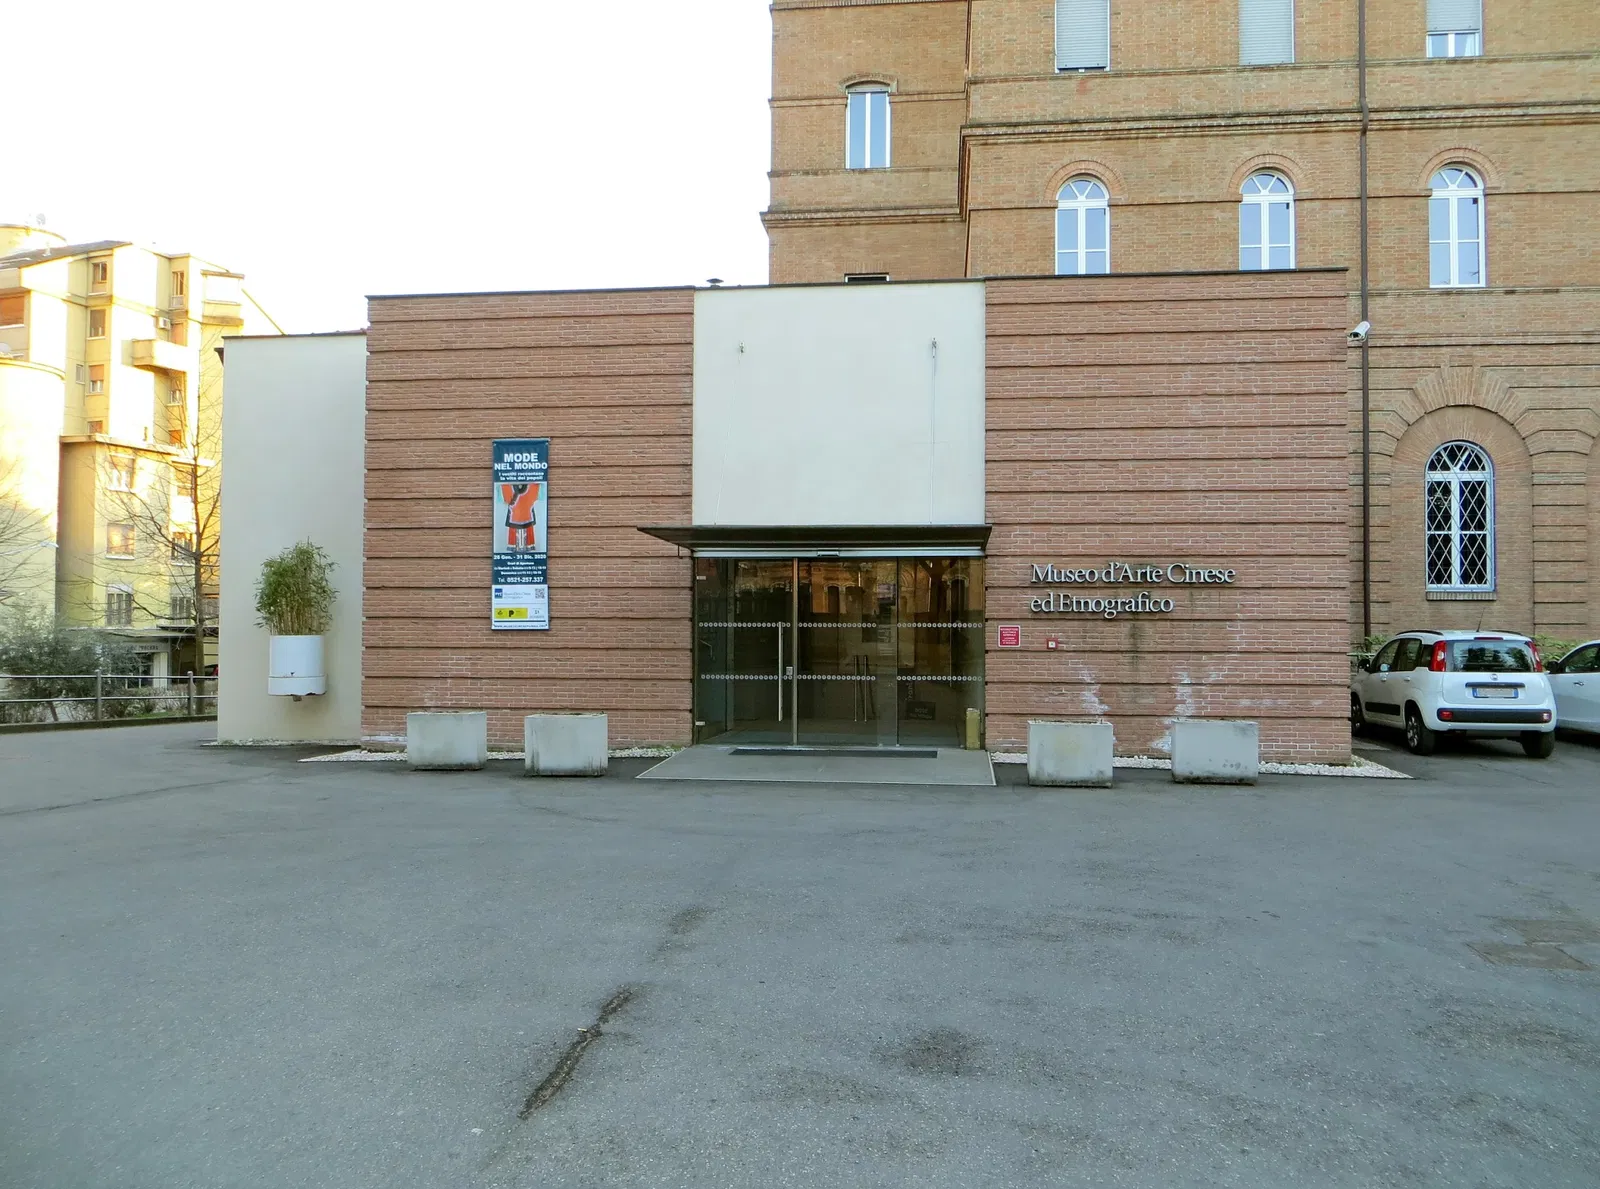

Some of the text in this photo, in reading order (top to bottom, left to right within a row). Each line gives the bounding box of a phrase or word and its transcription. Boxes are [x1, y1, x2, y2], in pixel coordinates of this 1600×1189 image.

[504, 453, 538, 462] MODE
[514, 462, 548, 470] MONDO
[1031, 562, 1236, 583] Museo d'Arte Cinese
[1030, 592, 1174, 619] ed Etnografico
